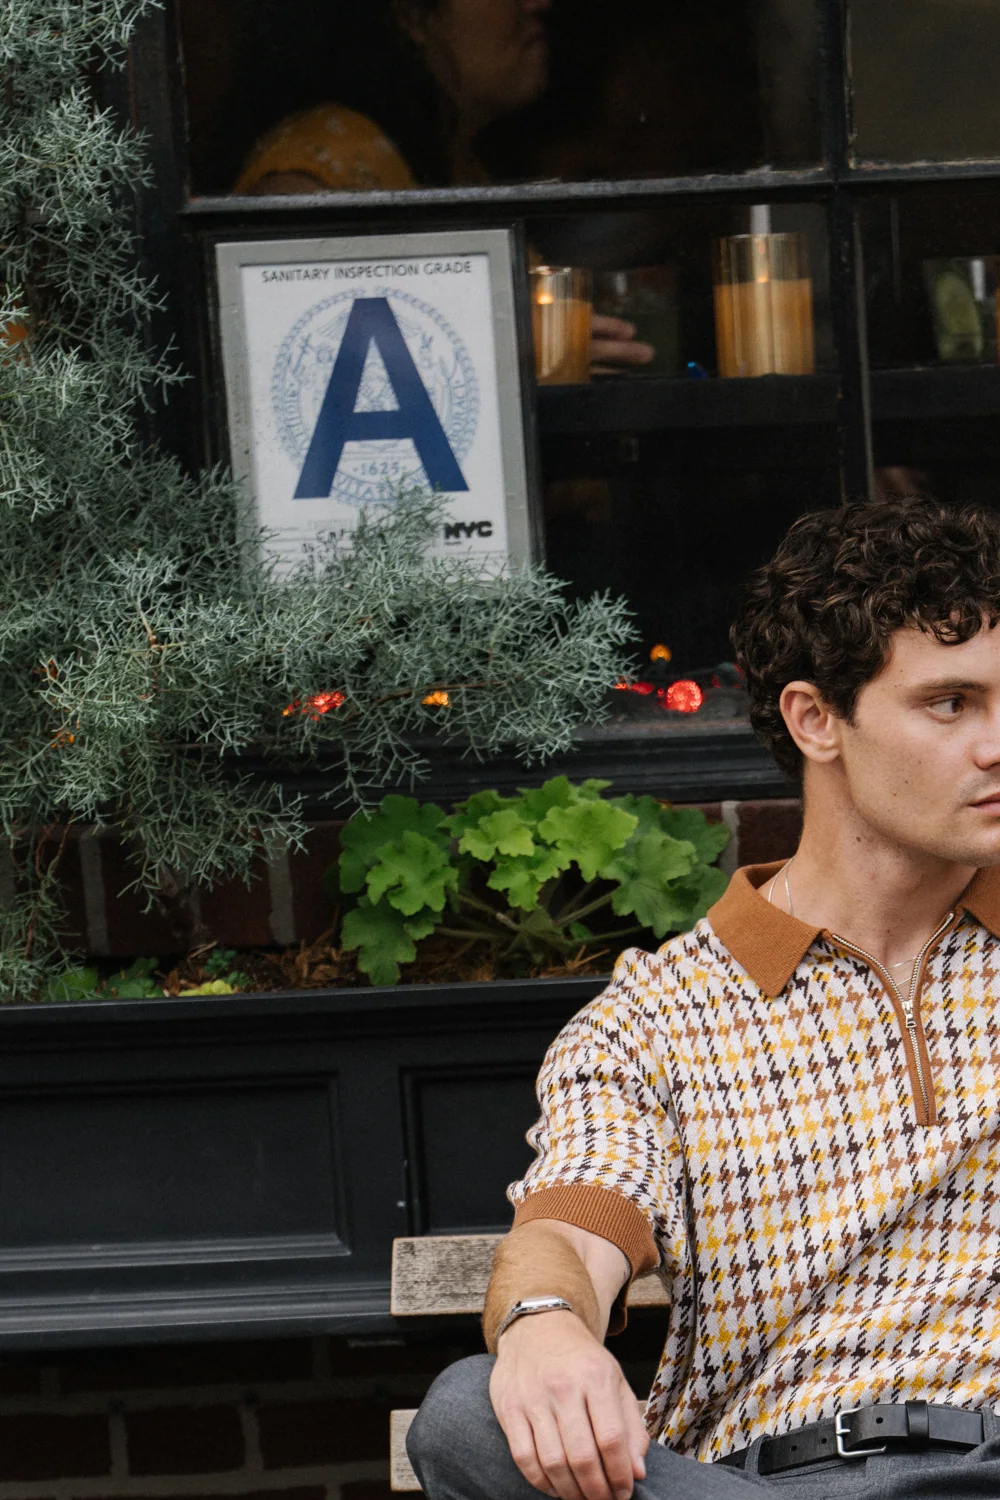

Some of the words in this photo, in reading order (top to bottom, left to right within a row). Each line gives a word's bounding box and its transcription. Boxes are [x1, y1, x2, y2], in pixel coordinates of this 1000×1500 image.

[260, 268, 330, 284] SANITARY
[334, 263, 419, 280] INSPECTION
[423, 260, 473, 276] GRADE
[293, 297, 470, 500] A
[444, 520, 493, 539] NYC
